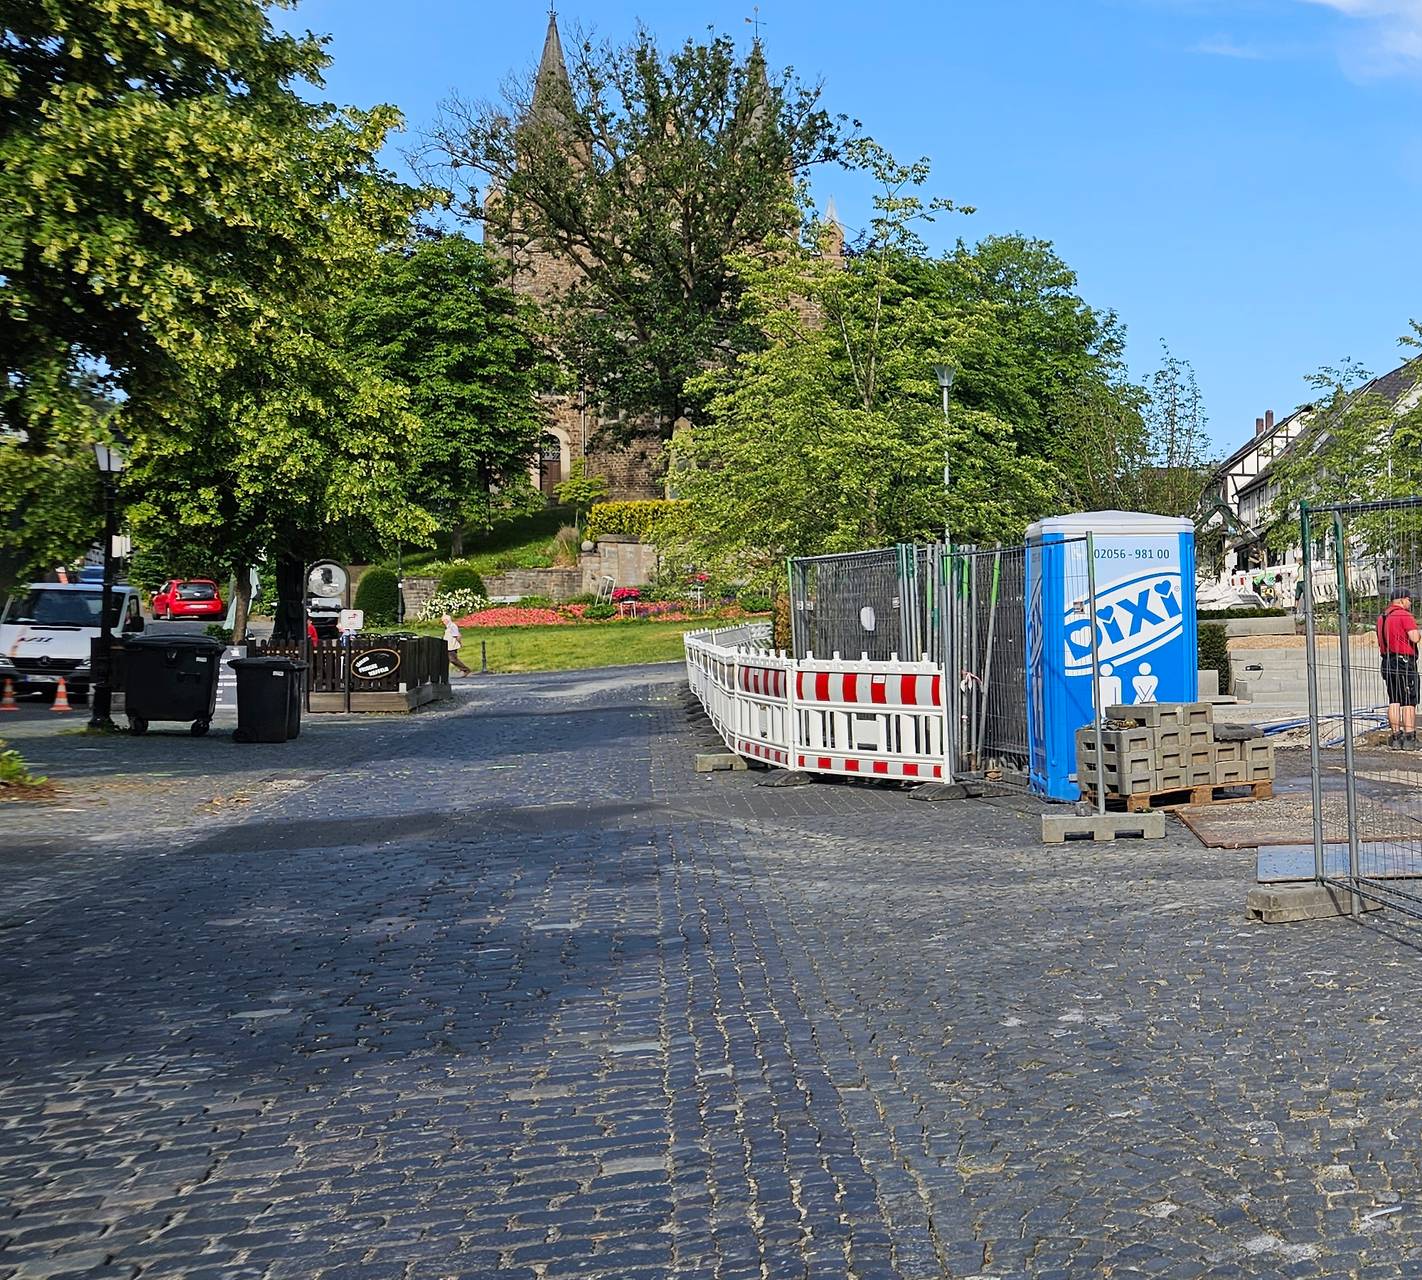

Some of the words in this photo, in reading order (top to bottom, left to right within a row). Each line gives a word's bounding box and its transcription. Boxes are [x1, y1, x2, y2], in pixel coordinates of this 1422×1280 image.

[1094, 549, 1126, 559] 02056
[1135, 549, 1154, 559] 981
[1157, 549, 1170, 559] 00
